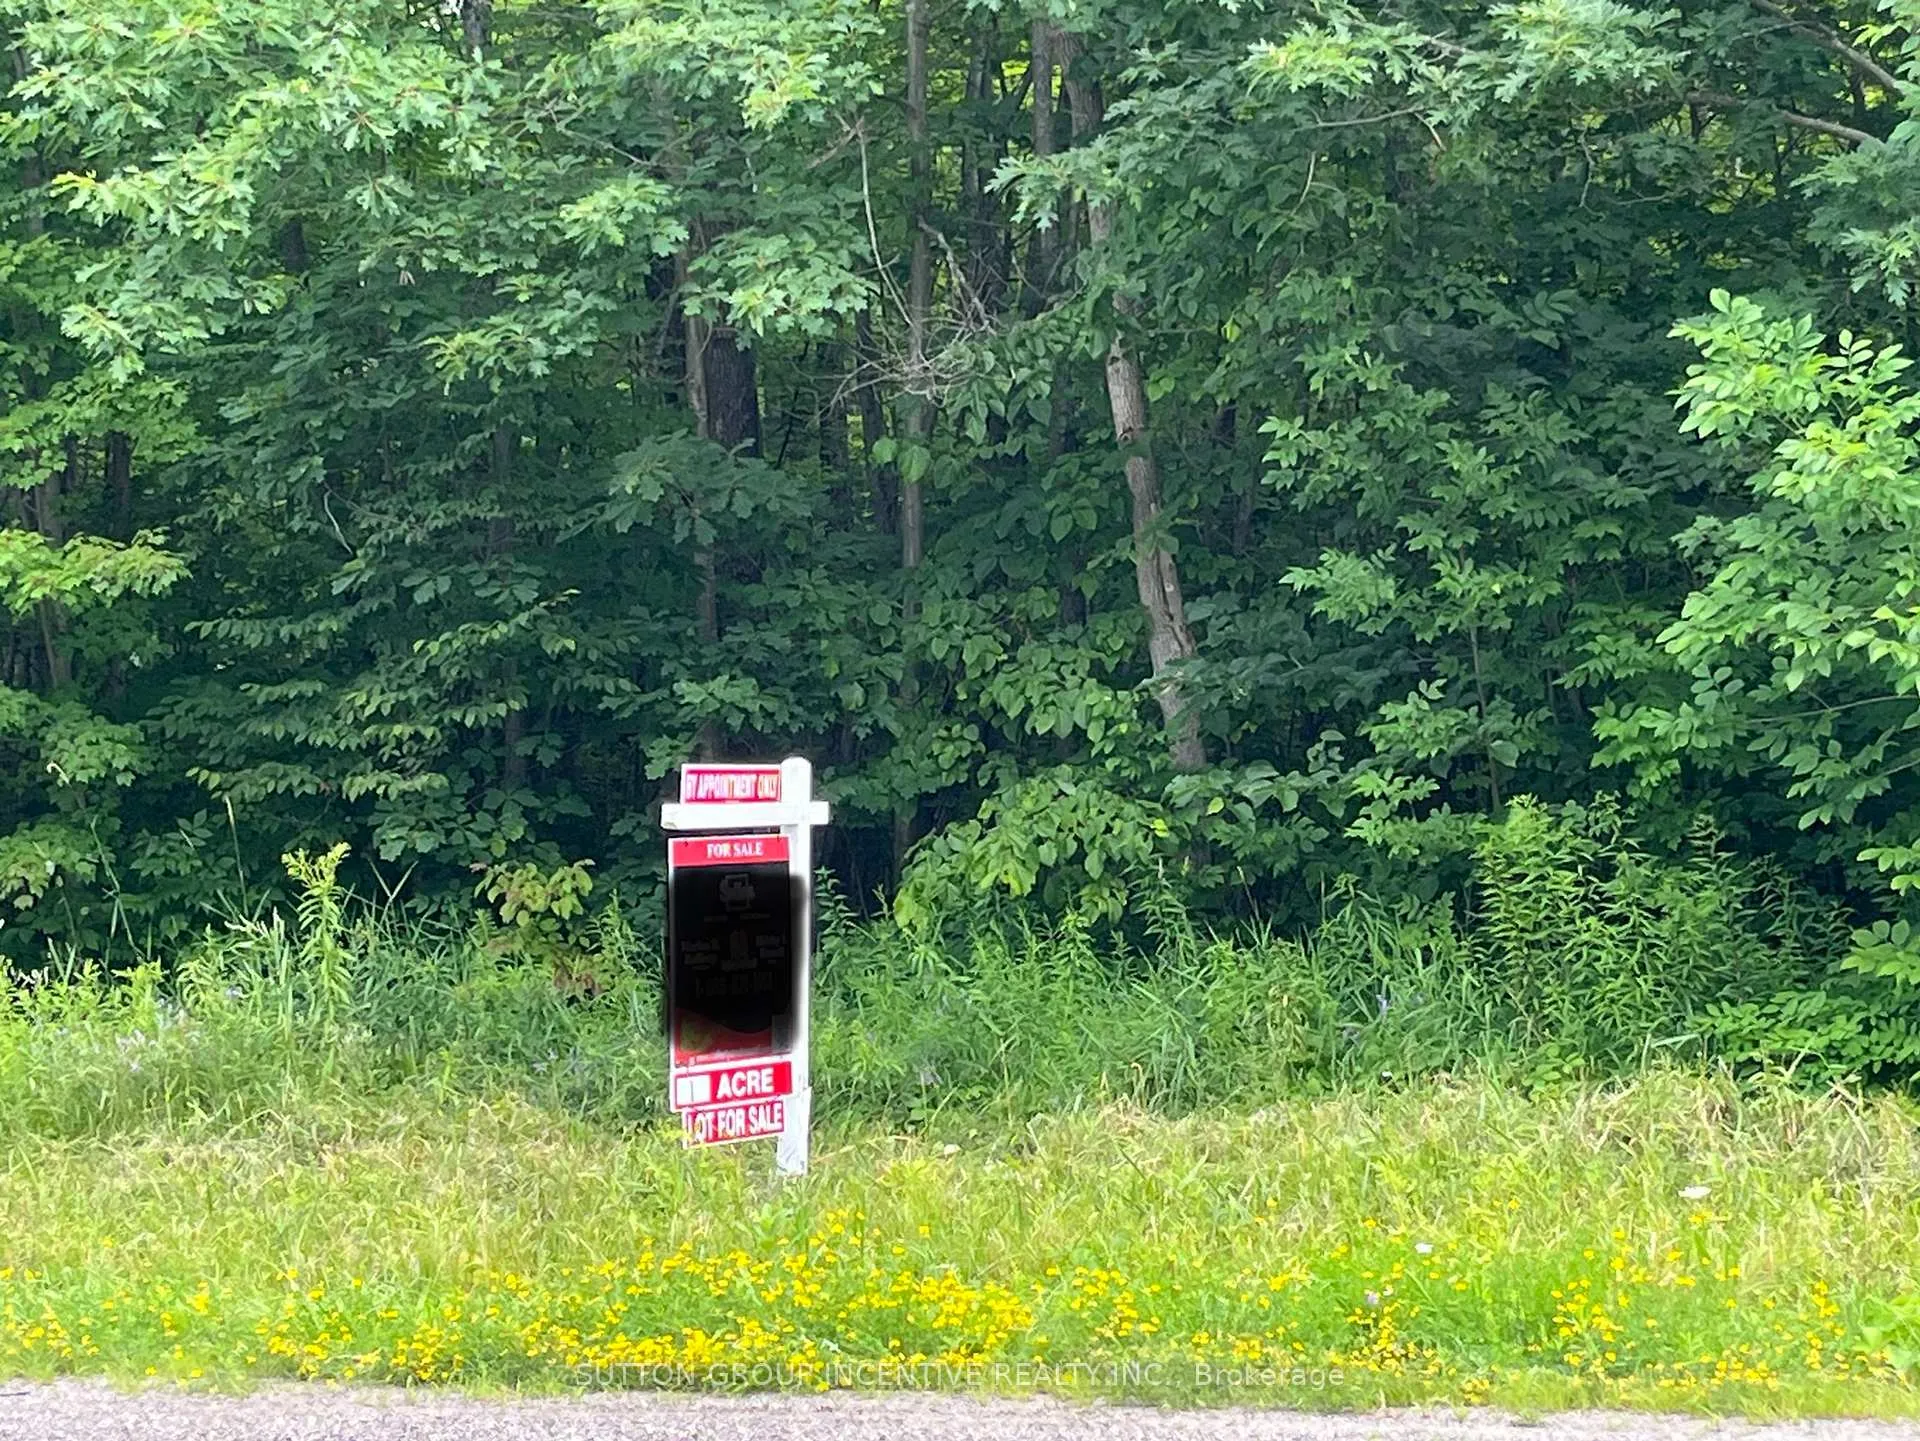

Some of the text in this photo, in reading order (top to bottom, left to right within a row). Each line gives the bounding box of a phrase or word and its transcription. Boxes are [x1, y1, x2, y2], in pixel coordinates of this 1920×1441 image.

[707, 841, 763, 858] FOR SALE
[716, 1068, 774, 1100] ACRE
[688, 1102, 783, 1146] LOT FOR SALE
